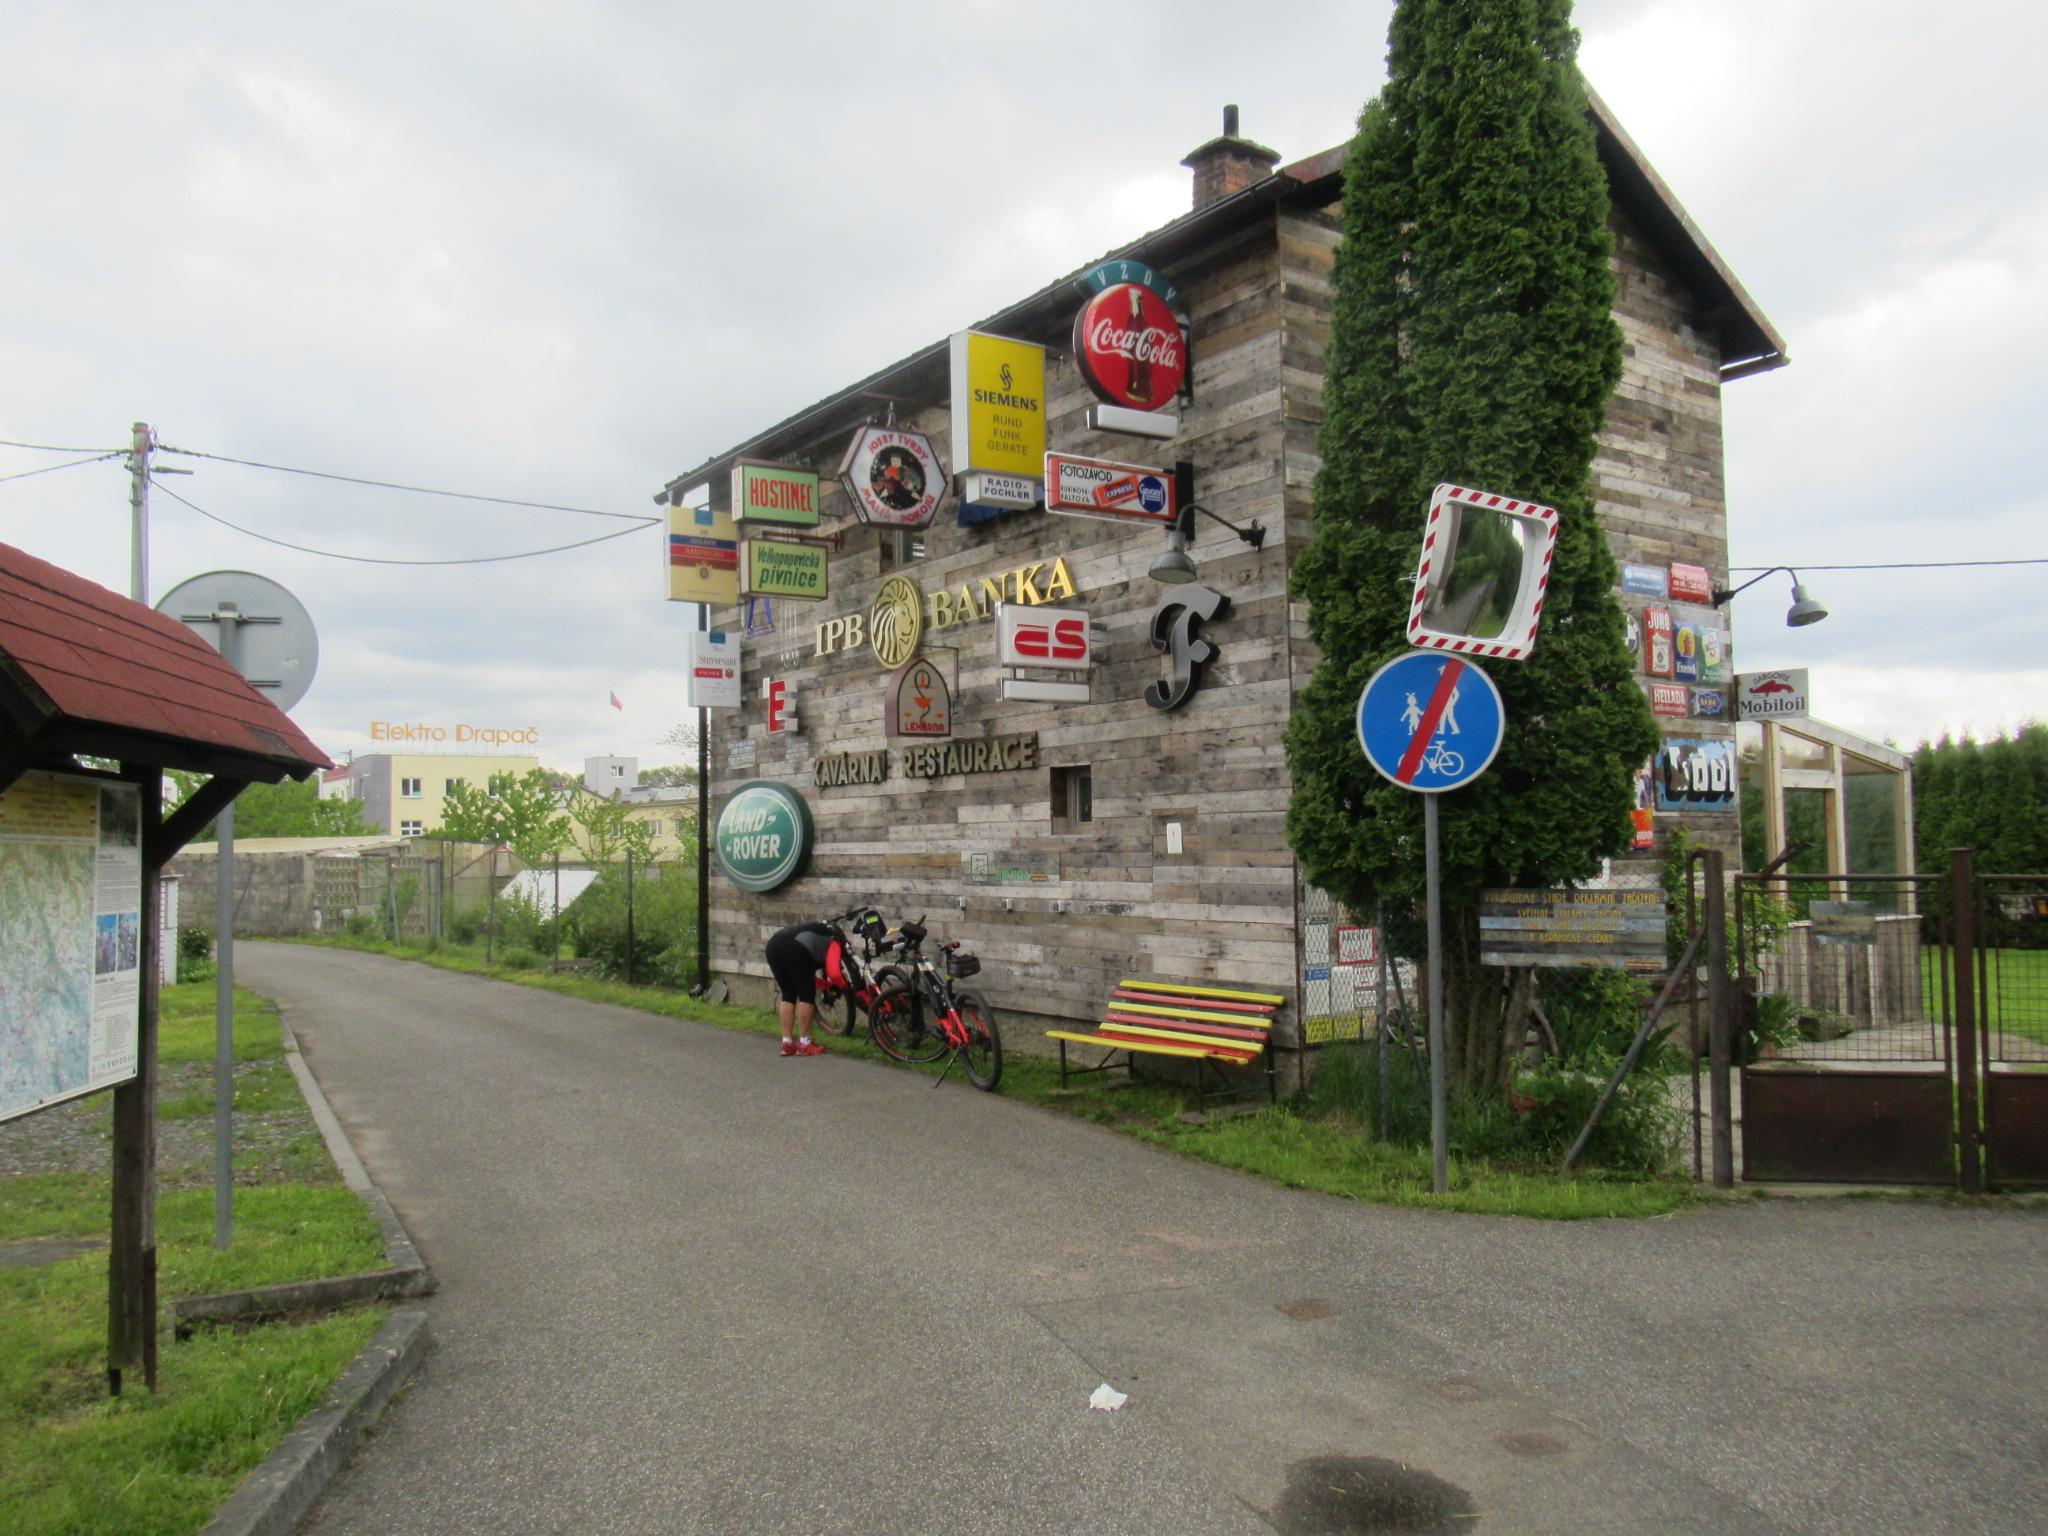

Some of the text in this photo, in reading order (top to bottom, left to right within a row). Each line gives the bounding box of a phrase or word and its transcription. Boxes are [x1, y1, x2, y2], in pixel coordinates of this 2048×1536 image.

[1091, 318, 1178, 368] Coca-Cola
[974, 389, 1038, 412] SIEMENS
[993, 414, 1022, 428] RUND
[868, 433, 894, 454] JOSEF
[993, 427, 1022, 442] FUNK
[750, 477, 813, 512] HOSTINEC
[984, 487, 1030, 499] FOCHLER
[758, 567, 818, 588] pivnice
[814, 556, 1079, 657] IPB BANKA
[1647, 611, 1671, 631] JUNO
[1653, 688, 1686, 704] HELLADA
[1740, 697, 1805, 714] Mobiloil
[371, 721, 539, 746] Elektro Drapač
[902, 736, 1034, 778] RESTAURACE
